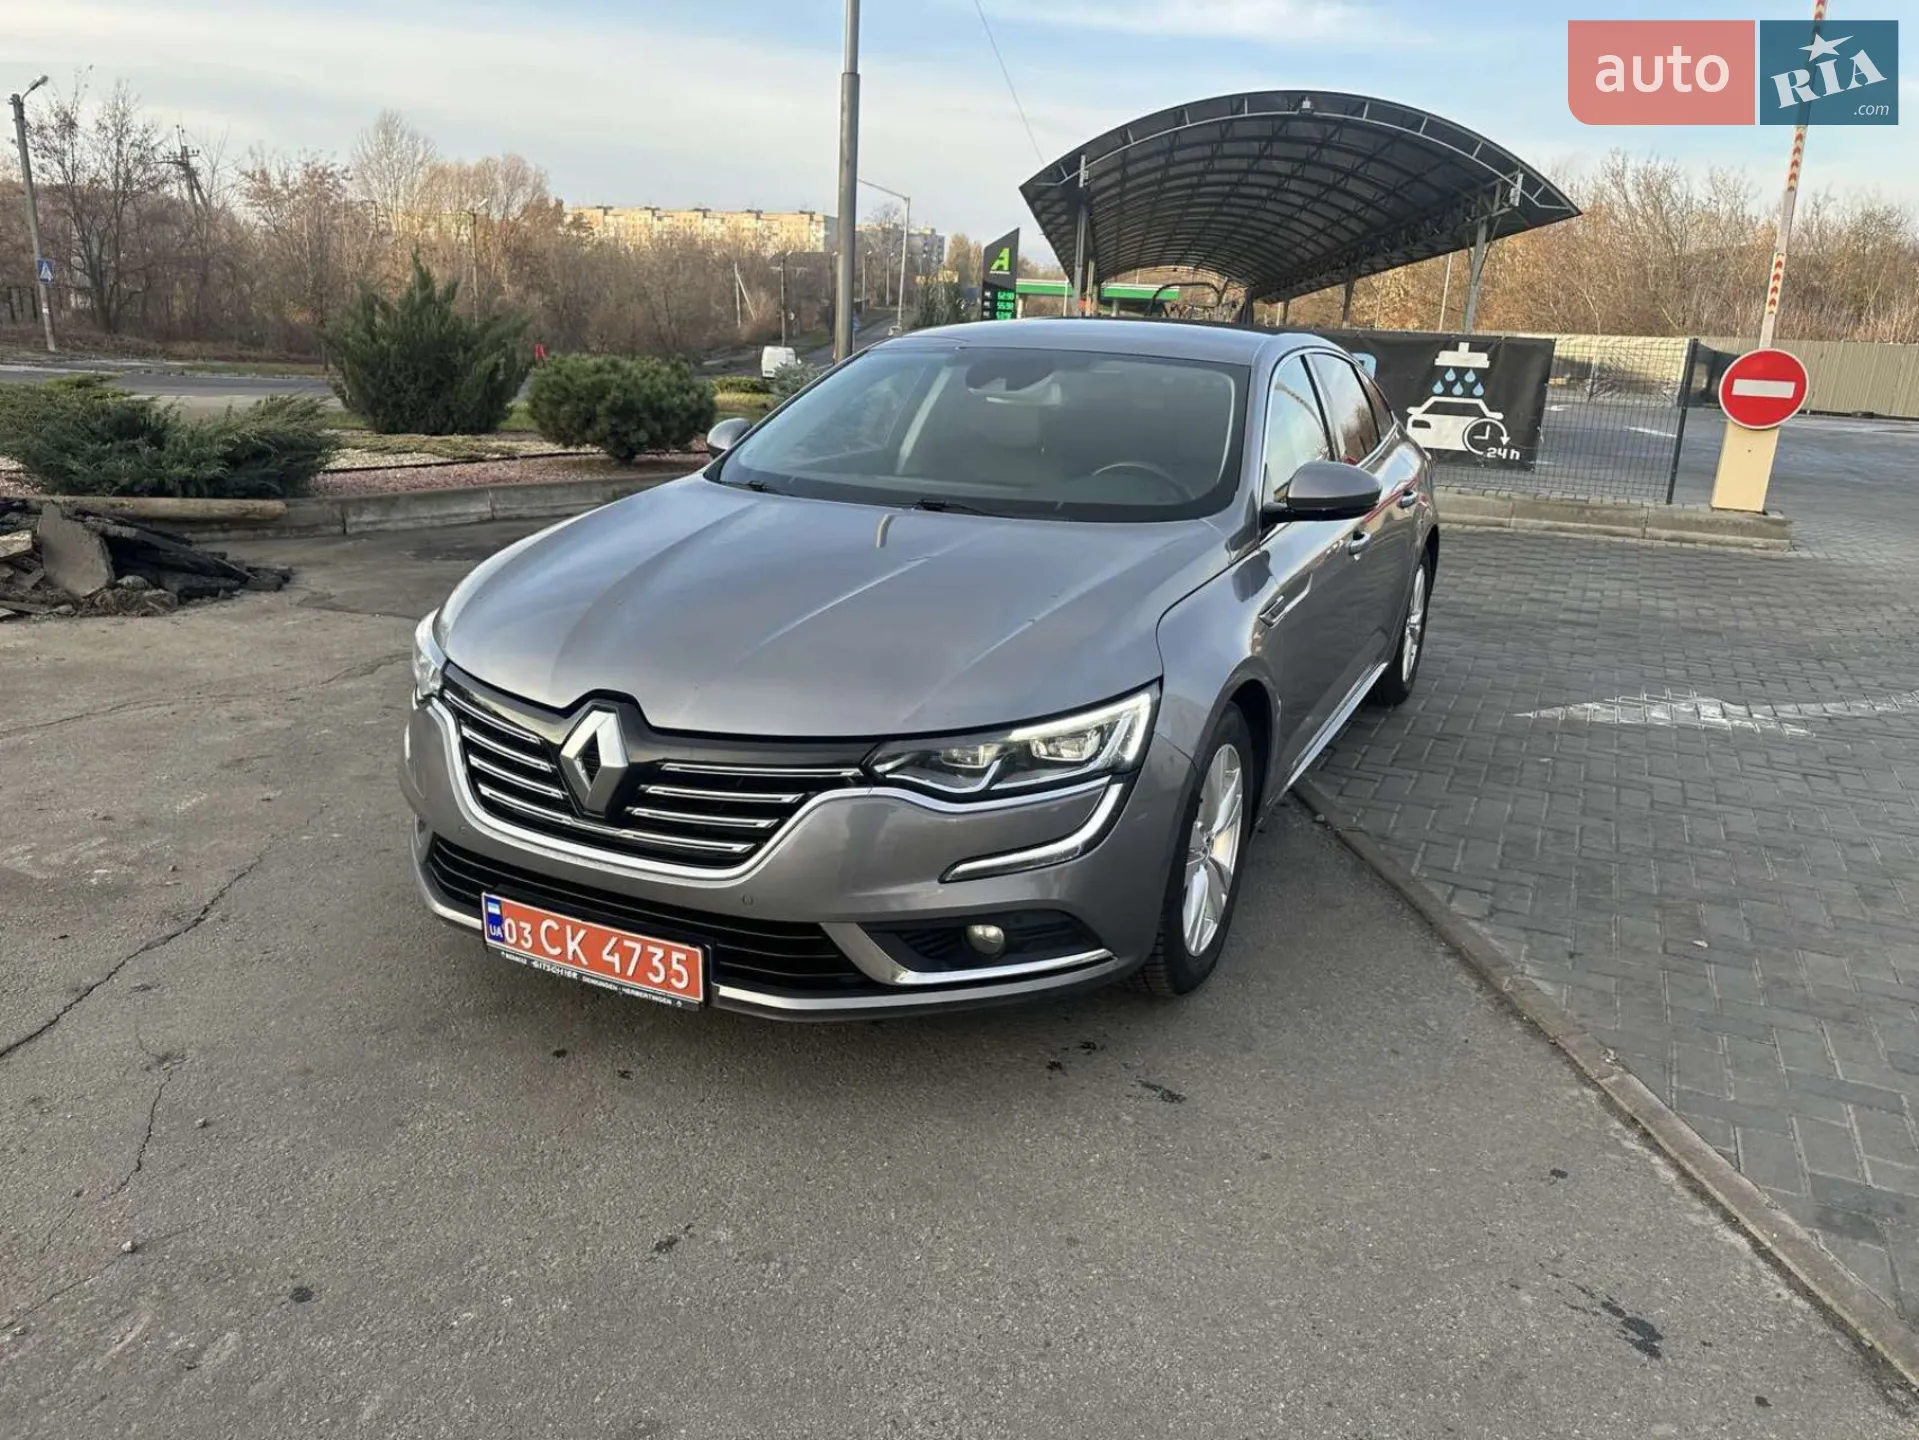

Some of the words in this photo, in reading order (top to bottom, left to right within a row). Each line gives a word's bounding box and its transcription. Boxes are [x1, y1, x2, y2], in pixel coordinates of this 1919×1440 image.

[489, 924, 503, 938] UA
[504, 917, 533, 949] 03
[540, 919, 589, 966] CK
[602, 937, 689, 989] 4735
